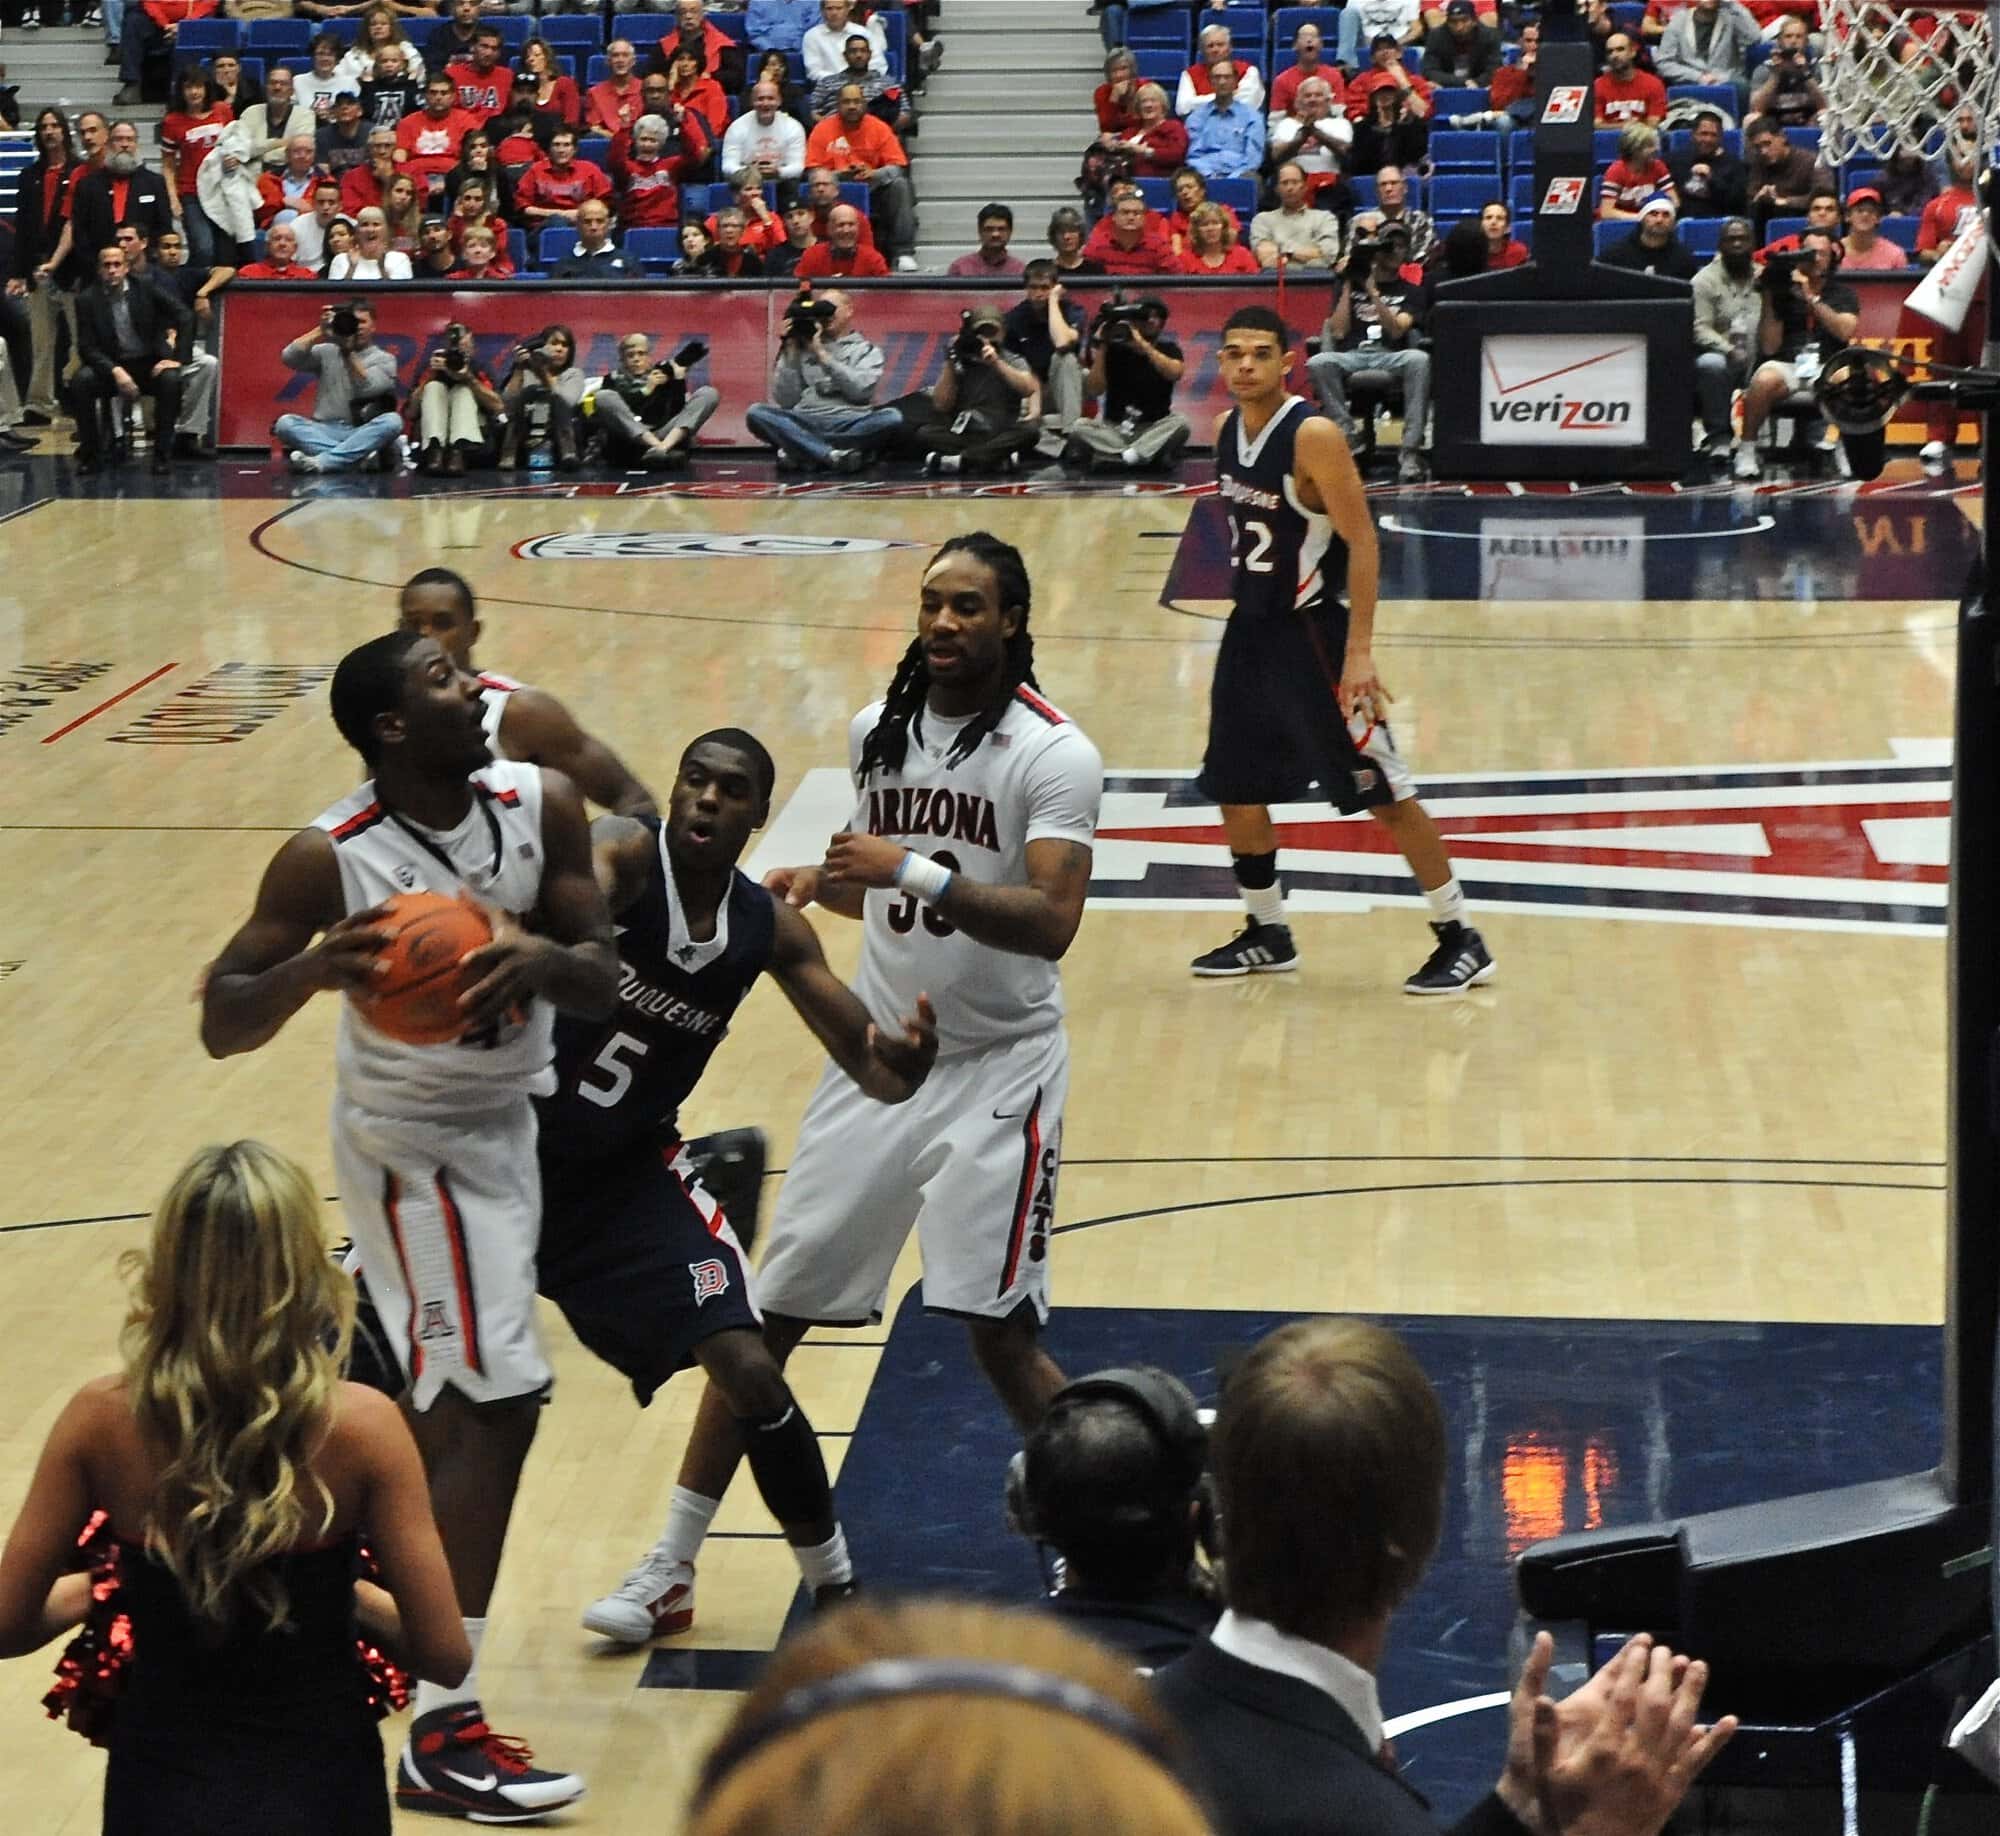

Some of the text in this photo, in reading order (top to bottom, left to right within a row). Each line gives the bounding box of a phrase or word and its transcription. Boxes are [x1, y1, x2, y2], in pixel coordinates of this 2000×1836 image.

[1490, 393, 1631, 430] verizon
[868, 787, 1001, 853] ARIZONA
[577, 1031, 649, 1108] 5
[1028, 1147, 1055, 1263] CATS
